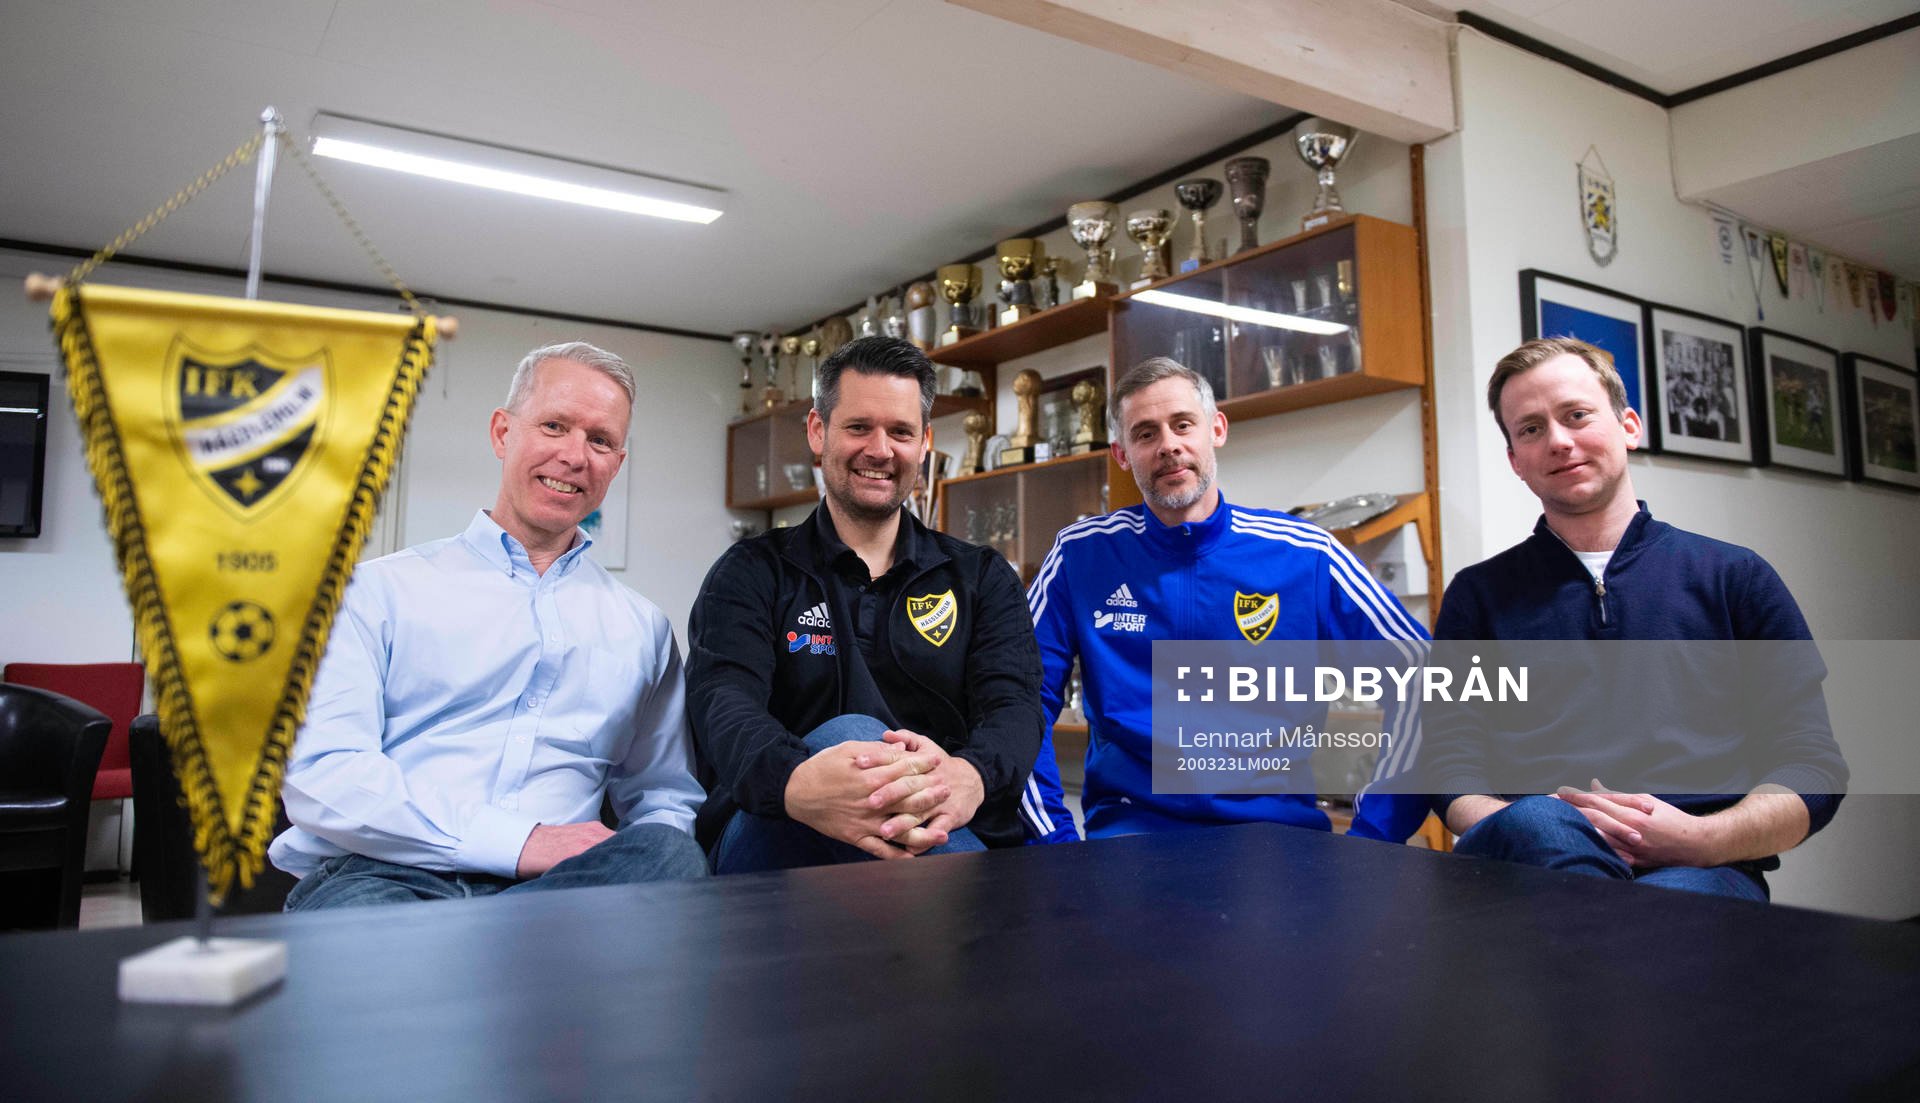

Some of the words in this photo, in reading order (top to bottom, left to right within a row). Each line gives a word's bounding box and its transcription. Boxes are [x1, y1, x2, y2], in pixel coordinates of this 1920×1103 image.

[185, 366, 260, 399] IFK
[911, 600, 934, 611] IFK
[1105, 597, 1138, 608] adidas
[1238, 599, 1259, 609] IFK
[1113, 612, 1148, 624] INTER
[1112, 621, 1146, 633] SPORT
[811, 633, 833, 645] INT
[810, 643, 836, 656] SPO
